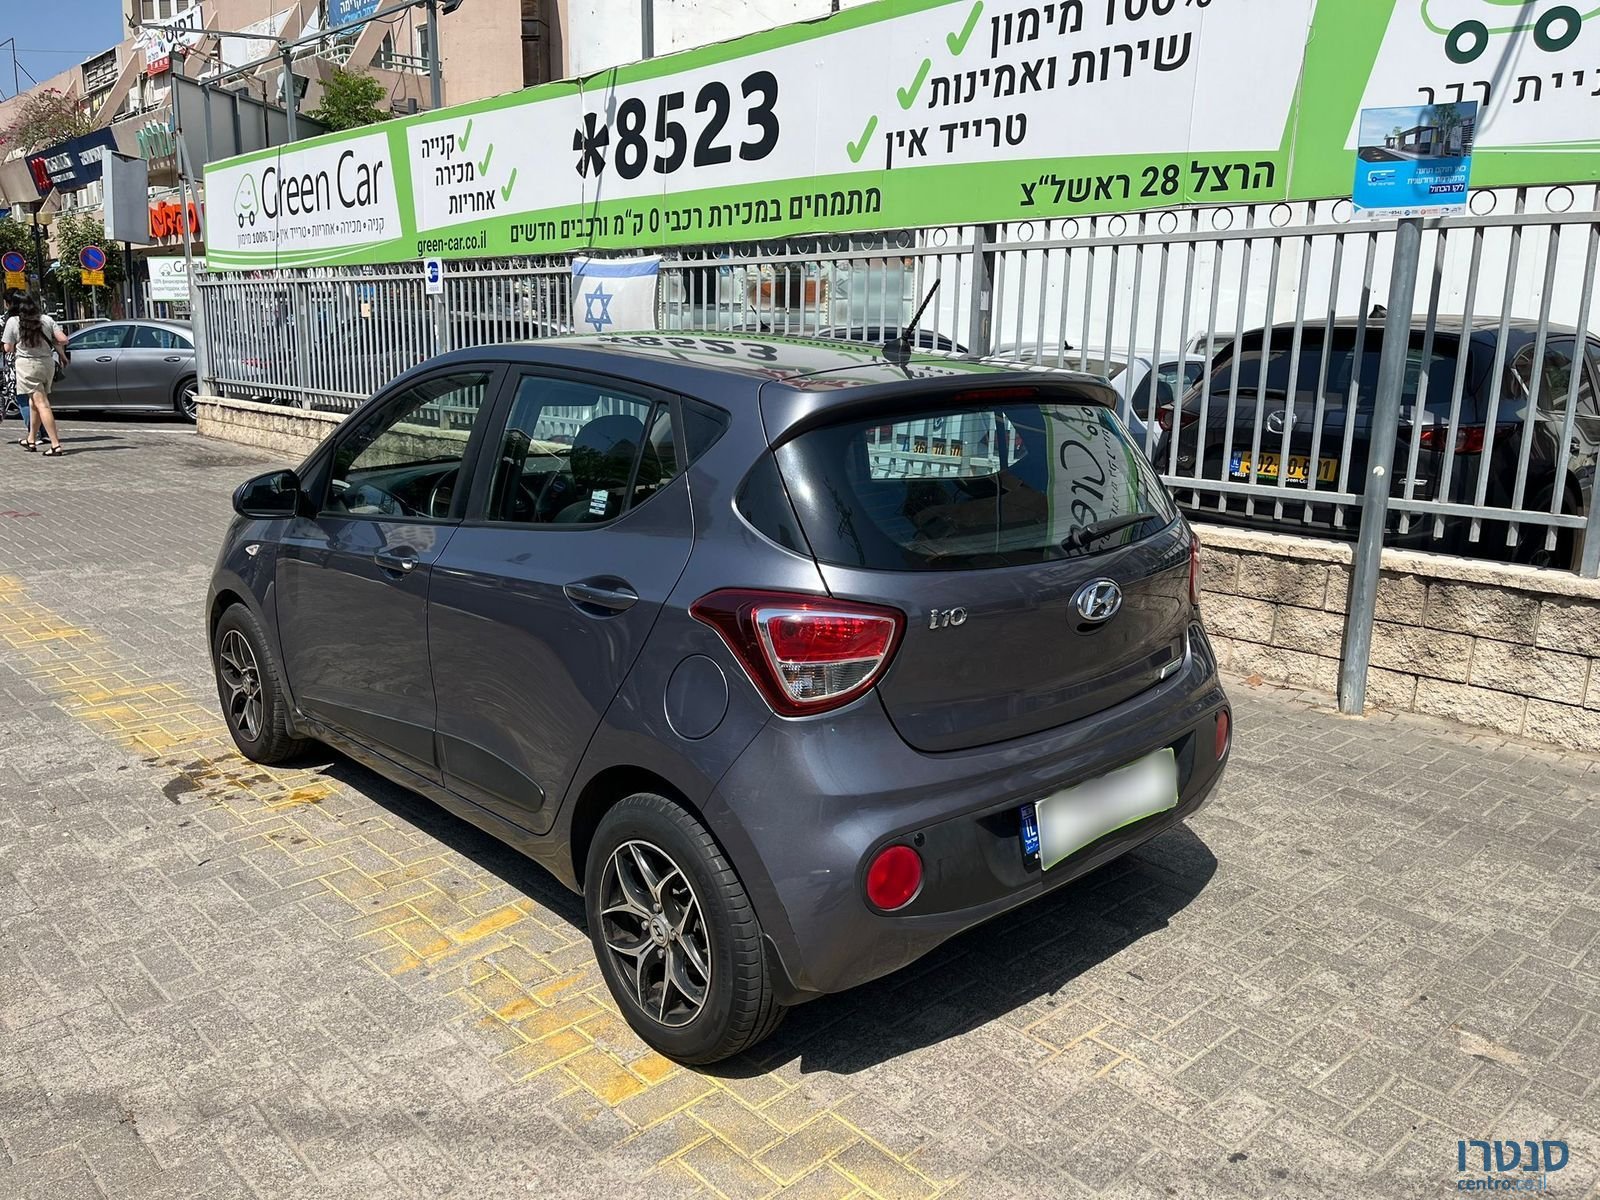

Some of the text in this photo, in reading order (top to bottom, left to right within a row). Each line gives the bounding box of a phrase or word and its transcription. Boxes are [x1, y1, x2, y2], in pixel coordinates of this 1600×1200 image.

[991, 0, 1083, 58] מימון
[928, 32, 1192, 109] שירות ואמינות
[421, 134, 455, 160] קנייה
[886, 113, 1027, 170] טרייד אין
[261, 150, 383, 219] Green Car
[435, 161, 475, 186] מכירה
[1140, 164, 1180, 197] 28
[1191, 160, 1275, 193] הרצל
[449, 189, 495, 215] אחריות
[708, 199, 782, 228] במכירת
[789, 187, 881, 220] מתמחים
[312, 224, 335, 237] אחריות
[340, 219, 362, 234] מכירה
[367, 217, 385, 235] קניה
[561, 216, 608, 239] ורכבים
[650, 208, 659, 232] 0
[665, 207, 702, 231] רכבי
[417, 231, 487, 257] green-car.co.il
[510, 222, 556, 243] חדשים
[929, 606, 968, 630] i10
[1025, 819, 1037, 838] IL
